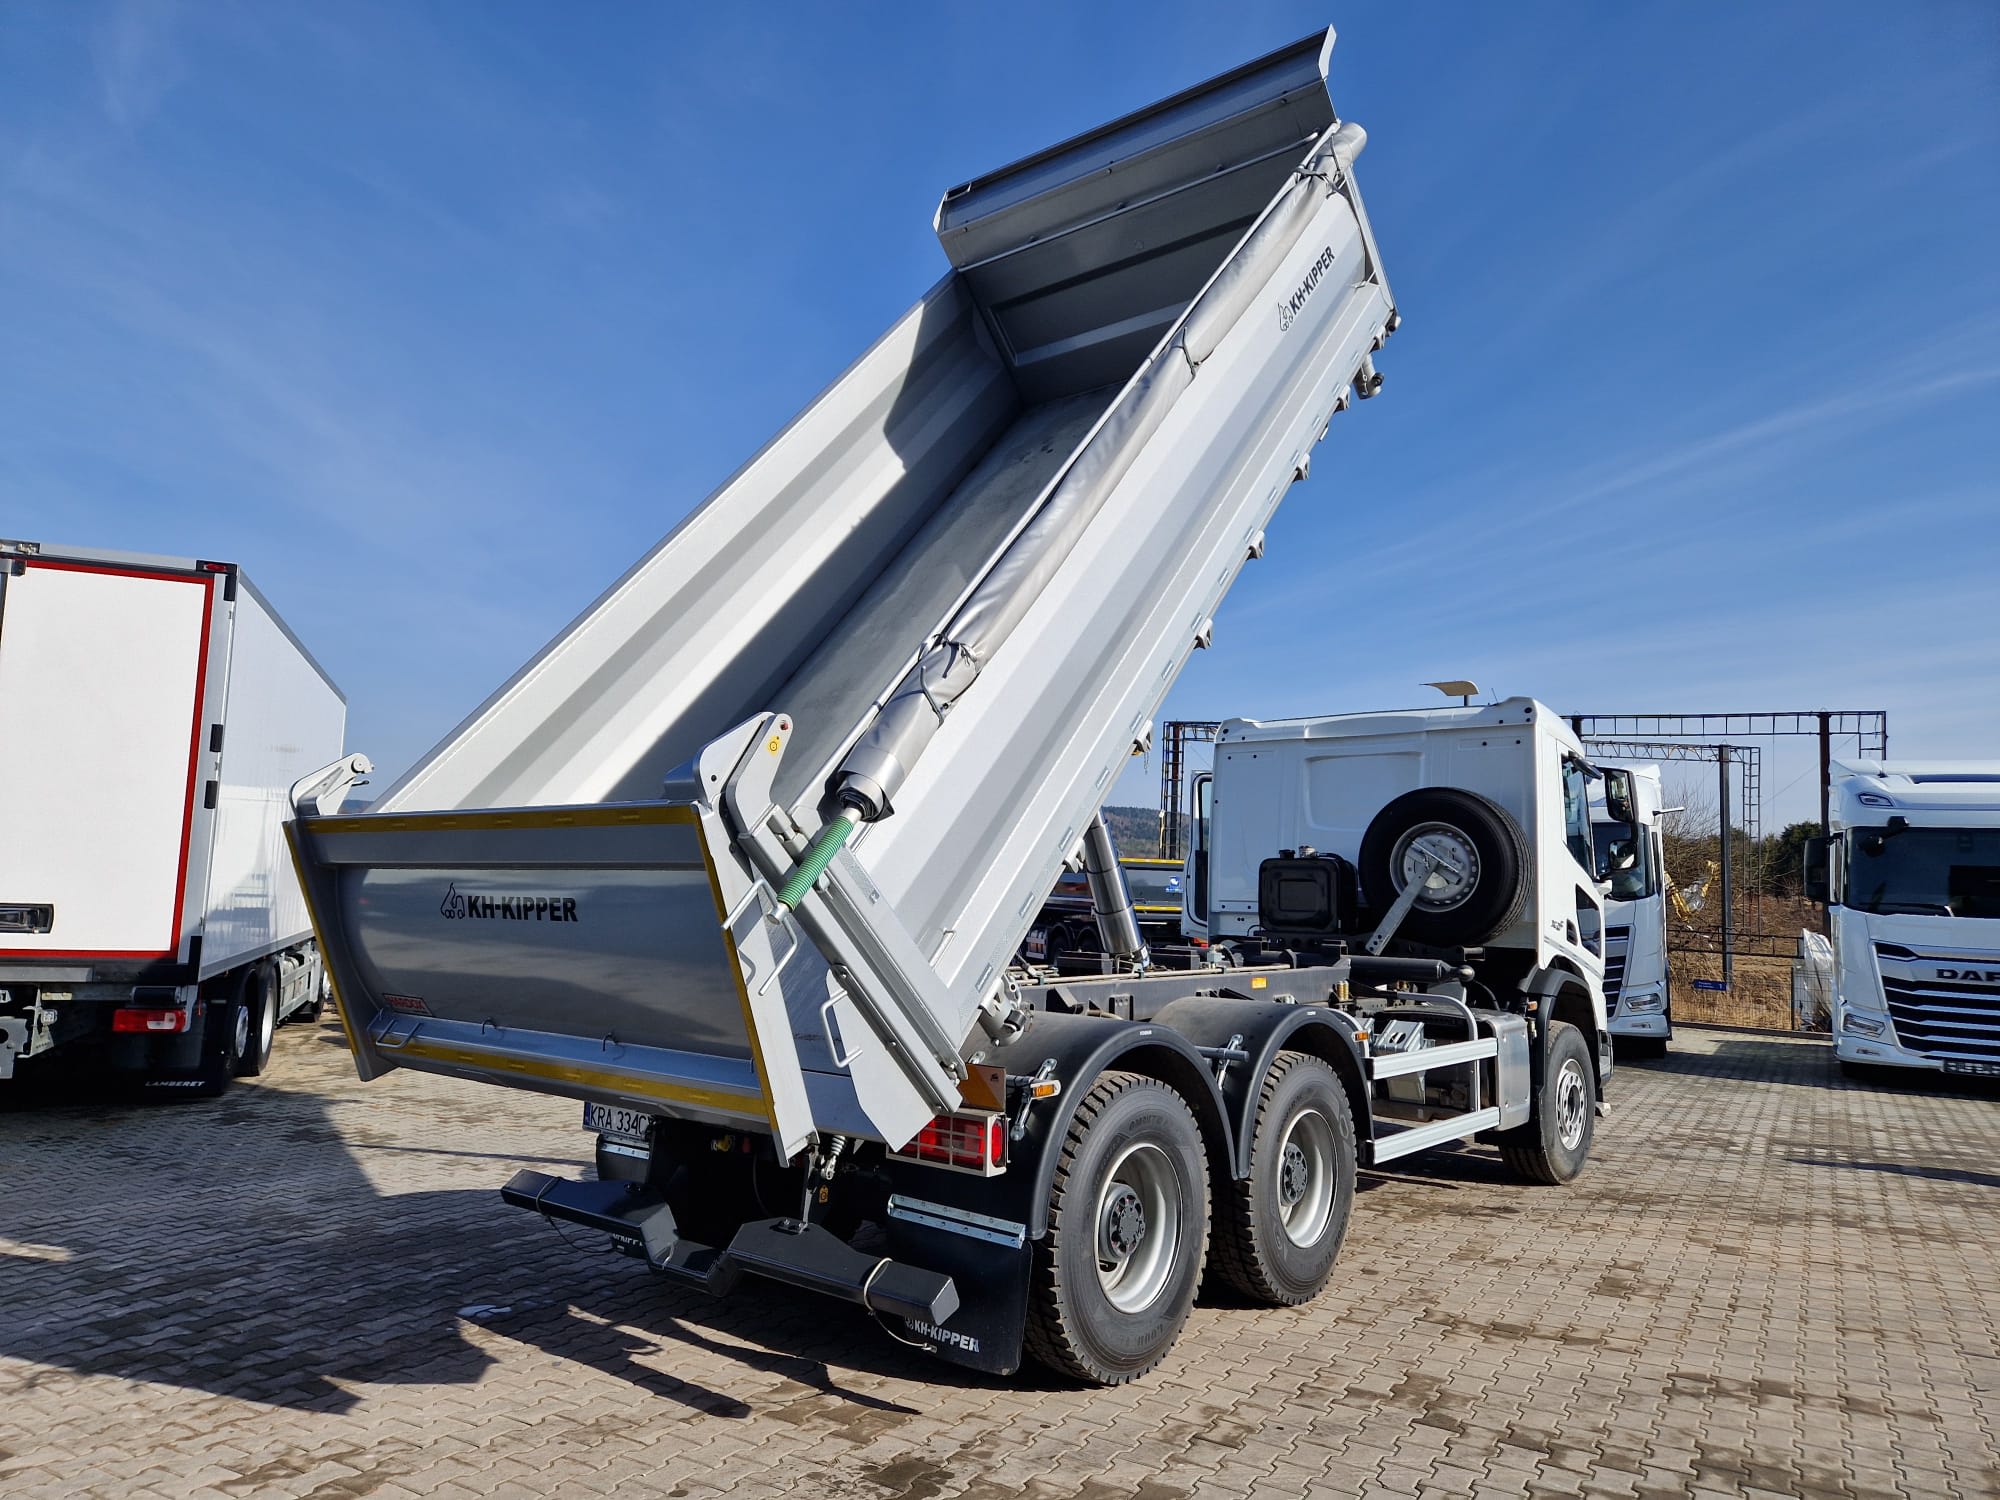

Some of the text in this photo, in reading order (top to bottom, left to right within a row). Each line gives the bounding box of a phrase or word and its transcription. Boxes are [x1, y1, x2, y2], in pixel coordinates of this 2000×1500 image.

[1289, 246, 1335, 315] KH-KIPPER
[467, 895, 578, 922] KH-KIPPER
[590, 1104, 612, 1129] KRA
[914, 1319, 980, 1353] KH-KIPPER
